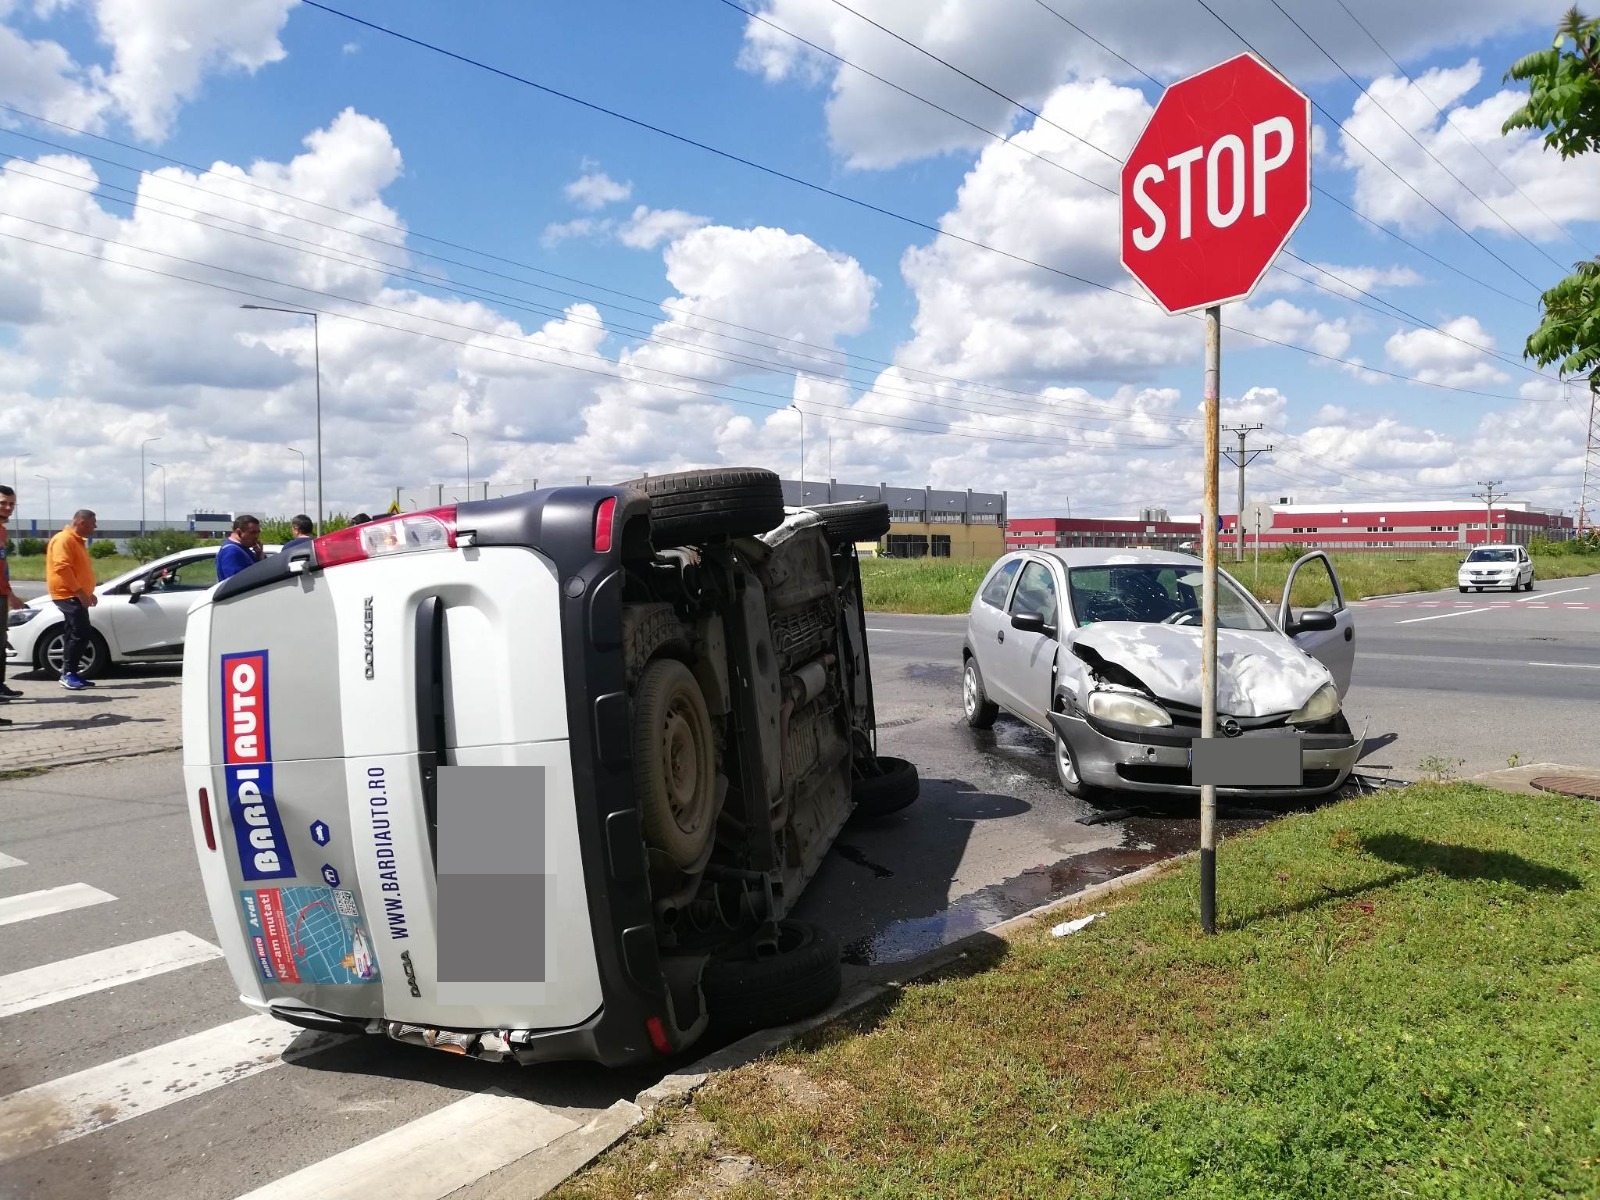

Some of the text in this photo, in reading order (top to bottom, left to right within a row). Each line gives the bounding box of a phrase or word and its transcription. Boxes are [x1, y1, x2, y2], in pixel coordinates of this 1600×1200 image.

[1132, 116, 1294, 252] STOP
[364, 595, 374, 680] DOKKER
[232, 663, 281, 873] BARDI AUTO
[367, 766, 409, 940] WWW.BARDIAUTO.RO
[244, 896, 259, 928] Arad
[259, 894, 277, 936] mutat!
[271, 939, 289, 979] Ne-am
[401, 950, 421, 998] DACIA
